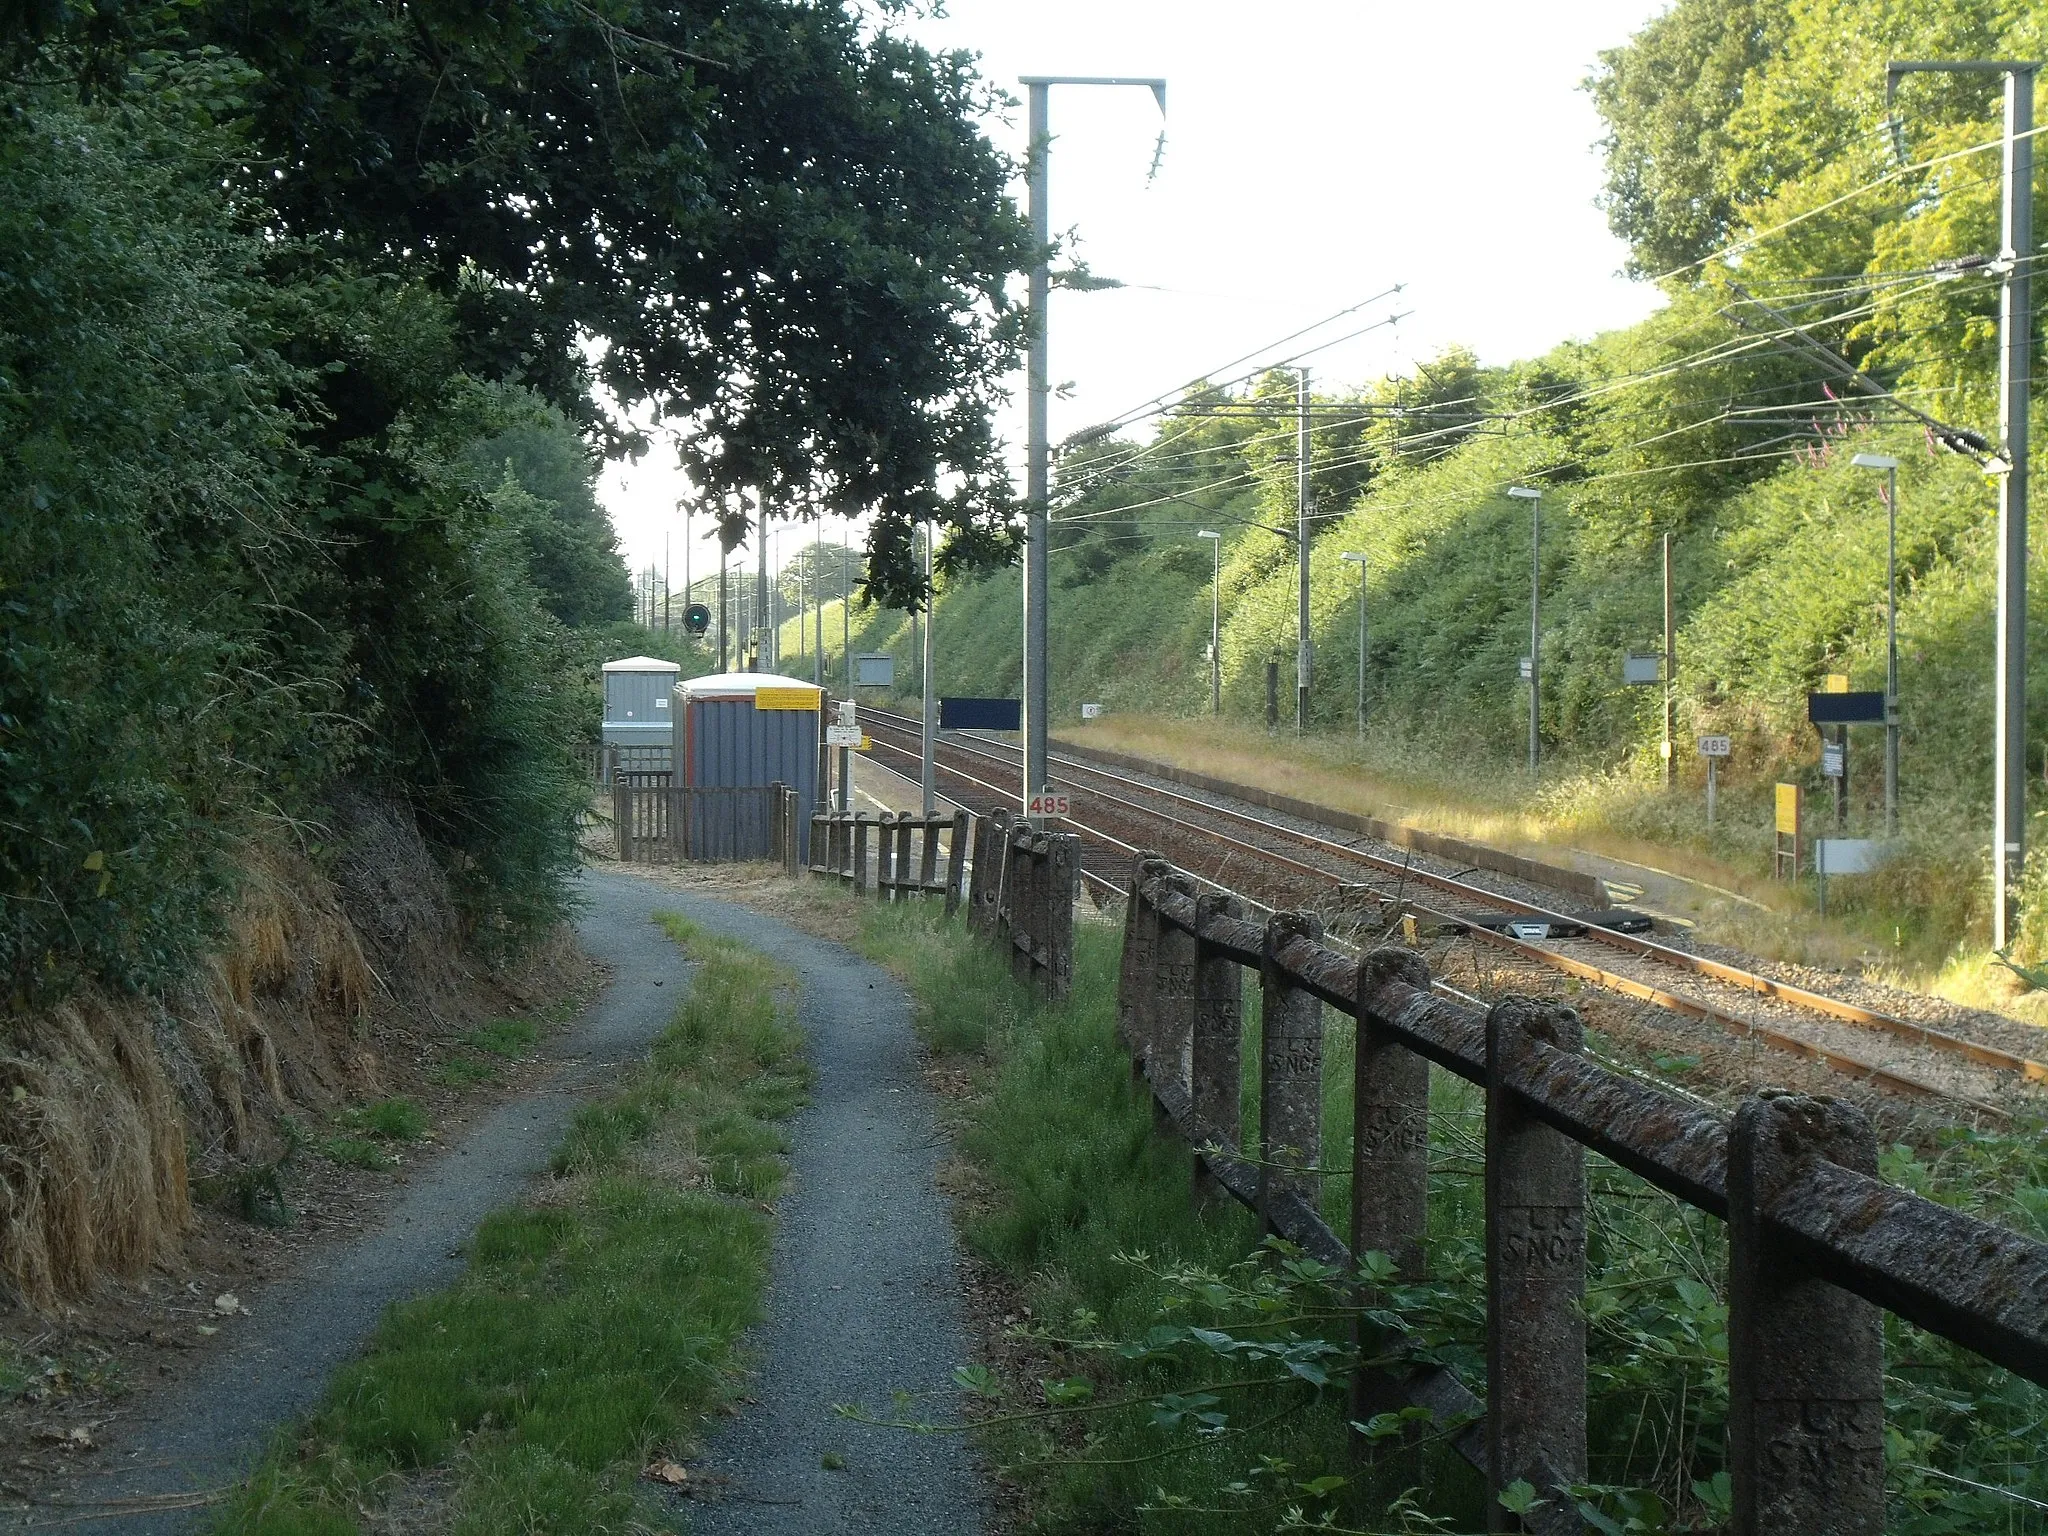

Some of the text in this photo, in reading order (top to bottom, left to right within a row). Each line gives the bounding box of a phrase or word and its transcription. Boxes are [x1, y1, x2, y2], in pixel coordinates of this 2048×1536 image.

[1699, 739, 1728, 752] 485
[1029, 796, 1068, 814] 485
[1503, 1233, 1585, 1267] SNCF
